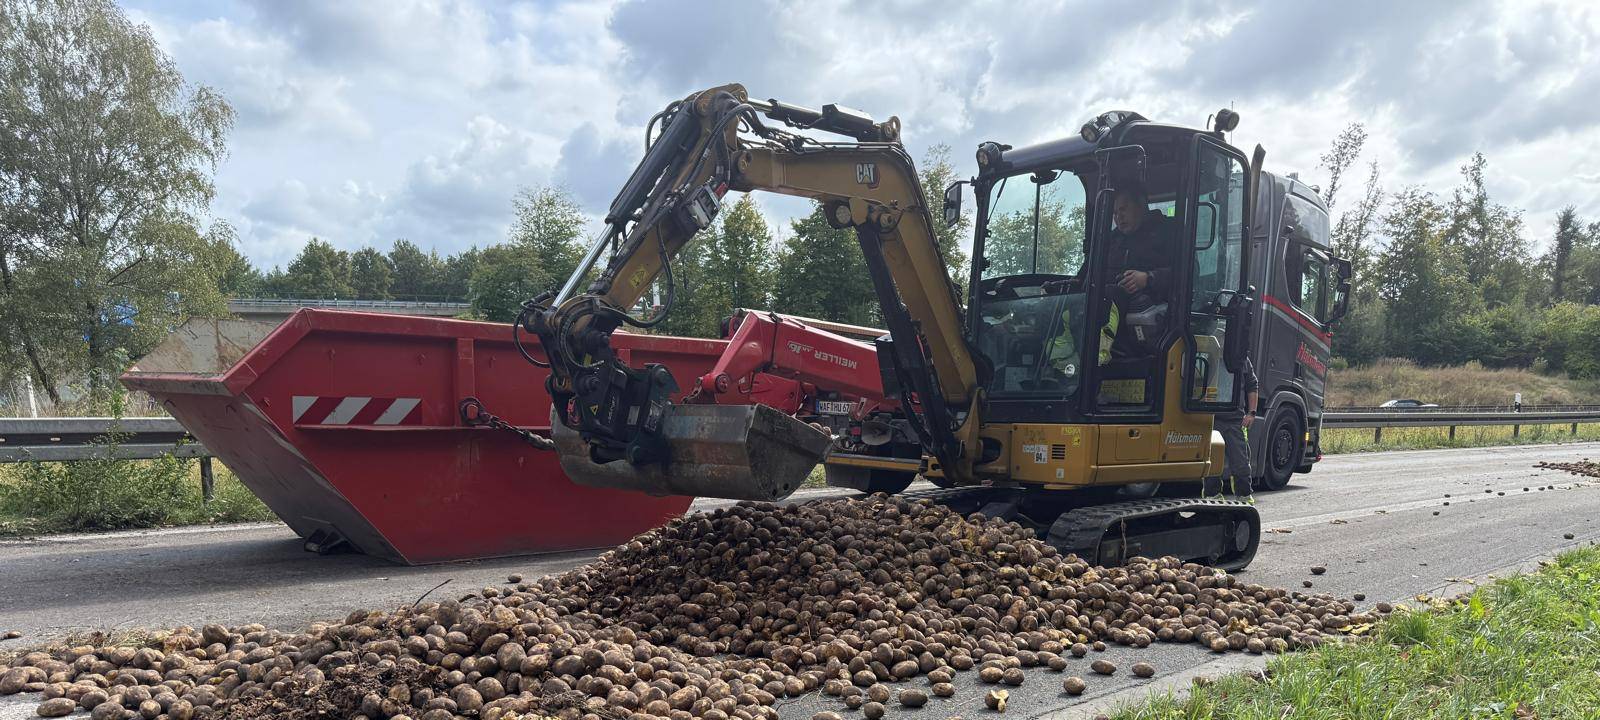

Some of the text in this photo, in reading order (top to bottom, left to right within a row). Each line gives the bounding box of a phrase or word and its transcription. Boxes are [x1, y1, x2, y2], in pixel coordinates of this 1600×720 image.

[856, 163, 875, 184] CAT
[814, 350, 857, 369] MEILLER
[819, 402, 830, 411] WAF
[833, 402, 842, 412] HU
[1165, 431, 1202, 445] Hülsmann
